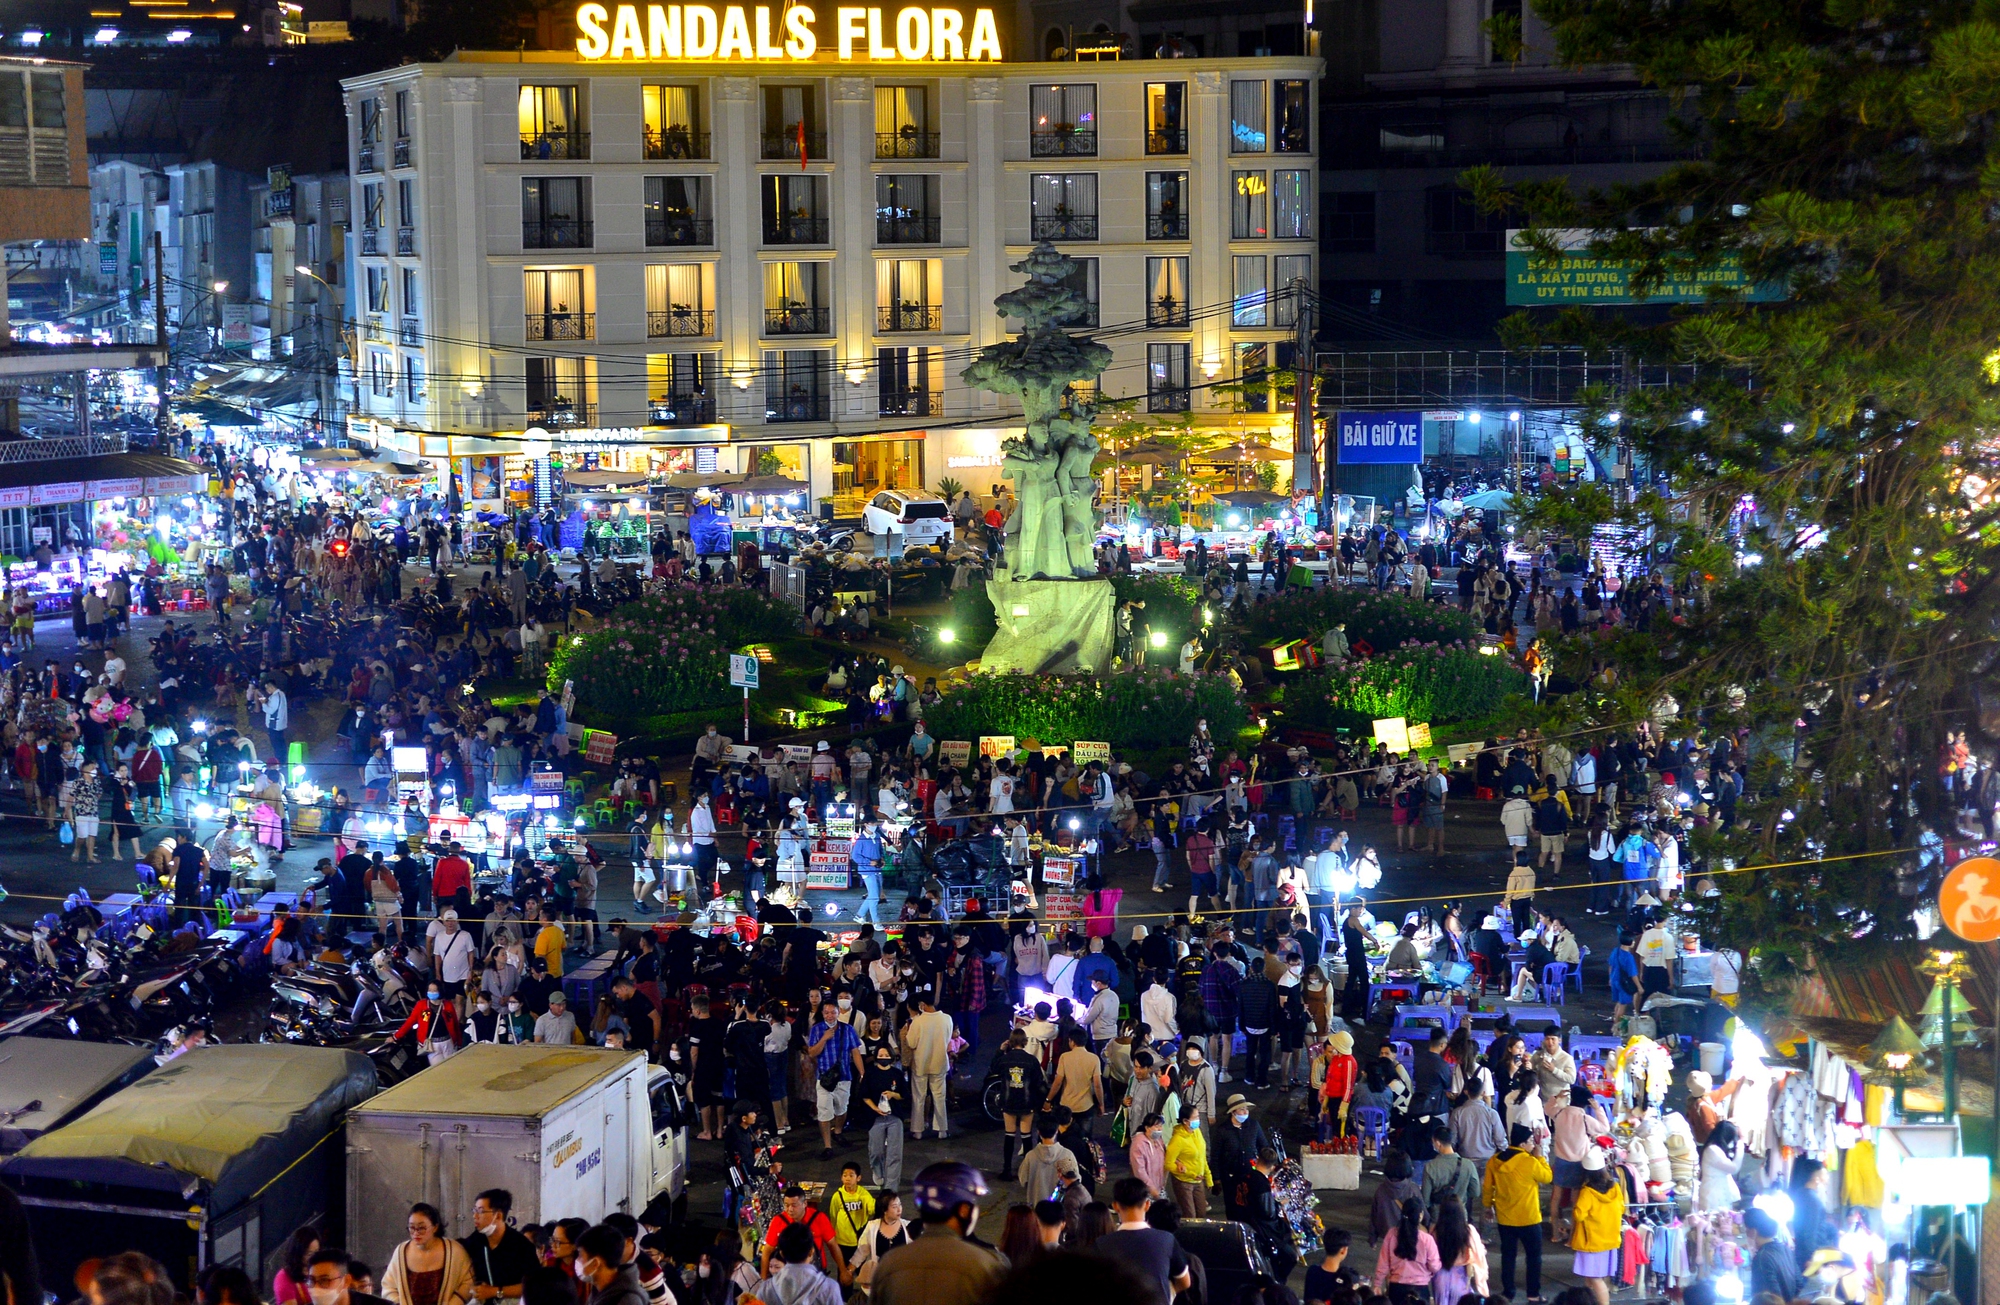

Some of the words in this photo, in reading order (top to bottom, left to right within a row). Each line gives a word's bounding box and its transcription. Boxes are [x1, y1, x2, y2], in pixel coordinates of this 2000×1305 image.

[576, 3, 818, 60] SANDALS
[837, 6, 1003, 61] FLORA
[1537, 286, 1558, 298] UY
[1561, 285, 1588, 298] TÍN
[1344, 421, 1367, 446] BÃI
[1371, 420, 1397, 446] GIỮ
[1399, 424, 1417, 446] XE
[980, 738, 997, 757] SỮA
[1076, 741, 1090, 749] SÚP
